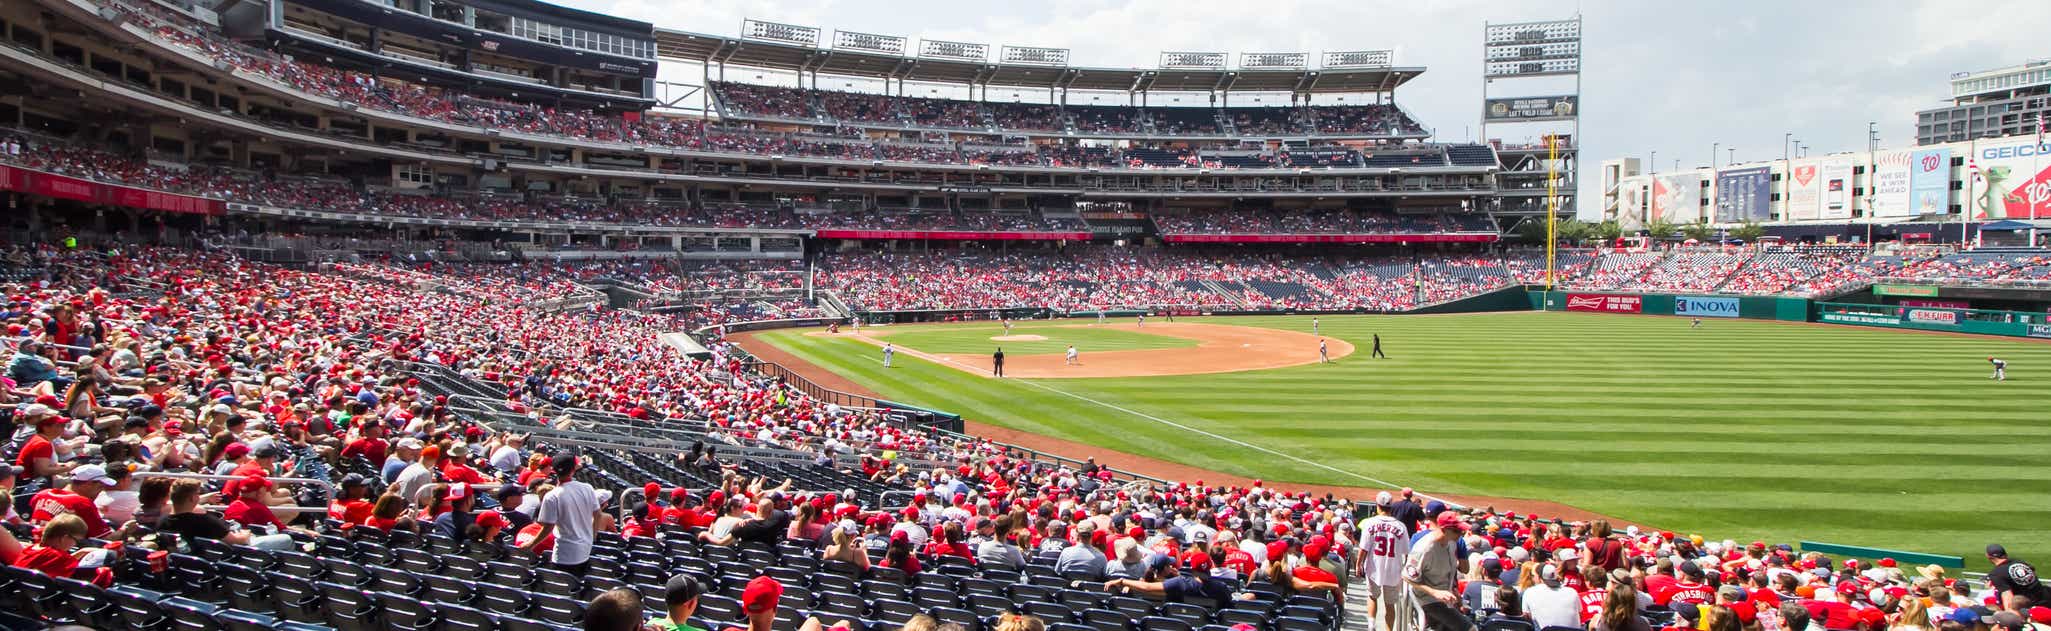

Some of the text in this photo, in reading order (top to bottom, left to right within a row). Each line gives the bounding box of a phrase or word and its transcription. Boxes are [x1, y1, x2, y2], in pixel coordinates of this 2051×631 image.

[1983, 144, 2051, 159] GEICO
[1691, 301, 1738, 312] INOVA
[1374, 536, 1395, 558] 31
